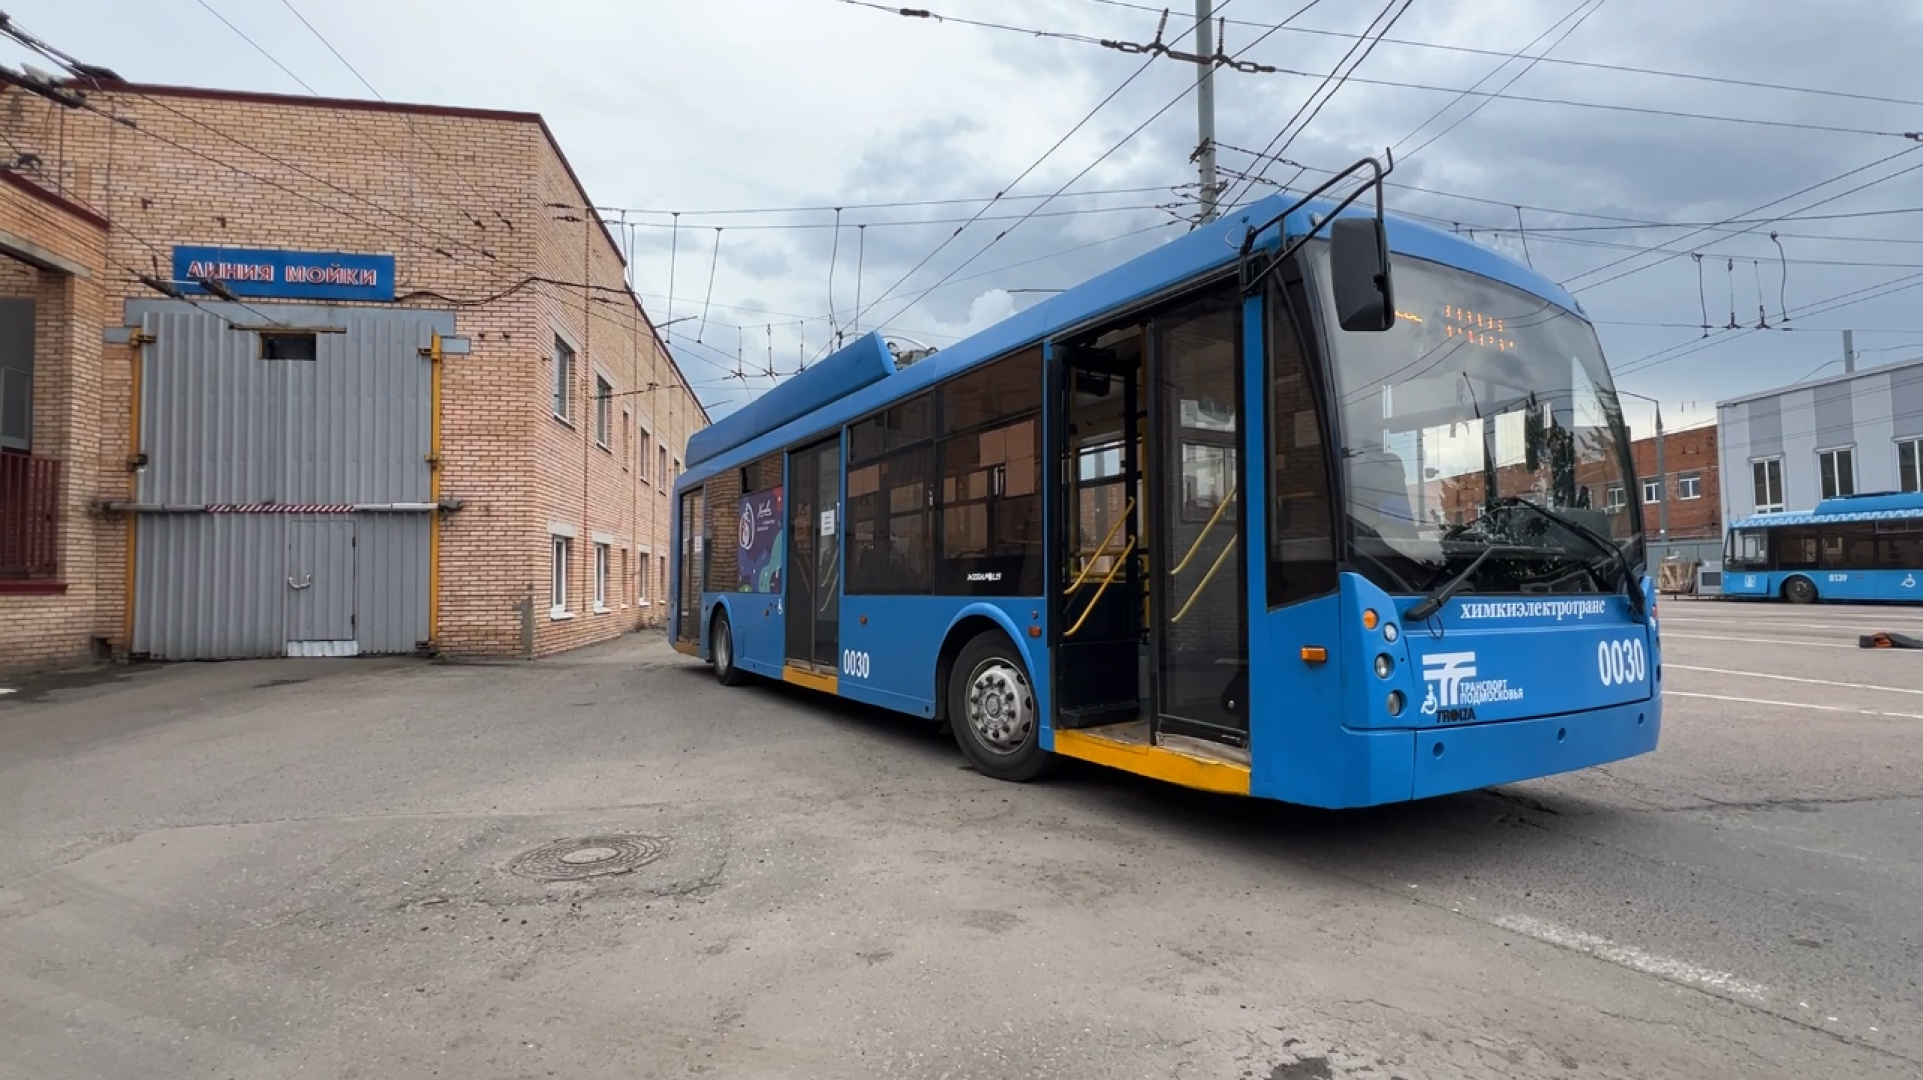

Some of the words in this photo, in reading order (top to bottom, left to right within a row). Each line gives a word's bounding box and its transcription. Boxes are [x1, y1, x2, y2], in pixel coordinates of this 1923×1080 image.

[186, 261, 275, 282] ЛИНИЯ
[285, 263, 377, 286] МОЙКИ
[1460, 600, 1606, 620] химкиэлектротранс
[842, 648, 870, 679] 0030
[1598, 638, 1646, 686] 0030
[1459, 680, 1508, 694] ТРАНСПОРТ
[1459, 688, 1524, 705] ПОДМОСКОВЬЯ
